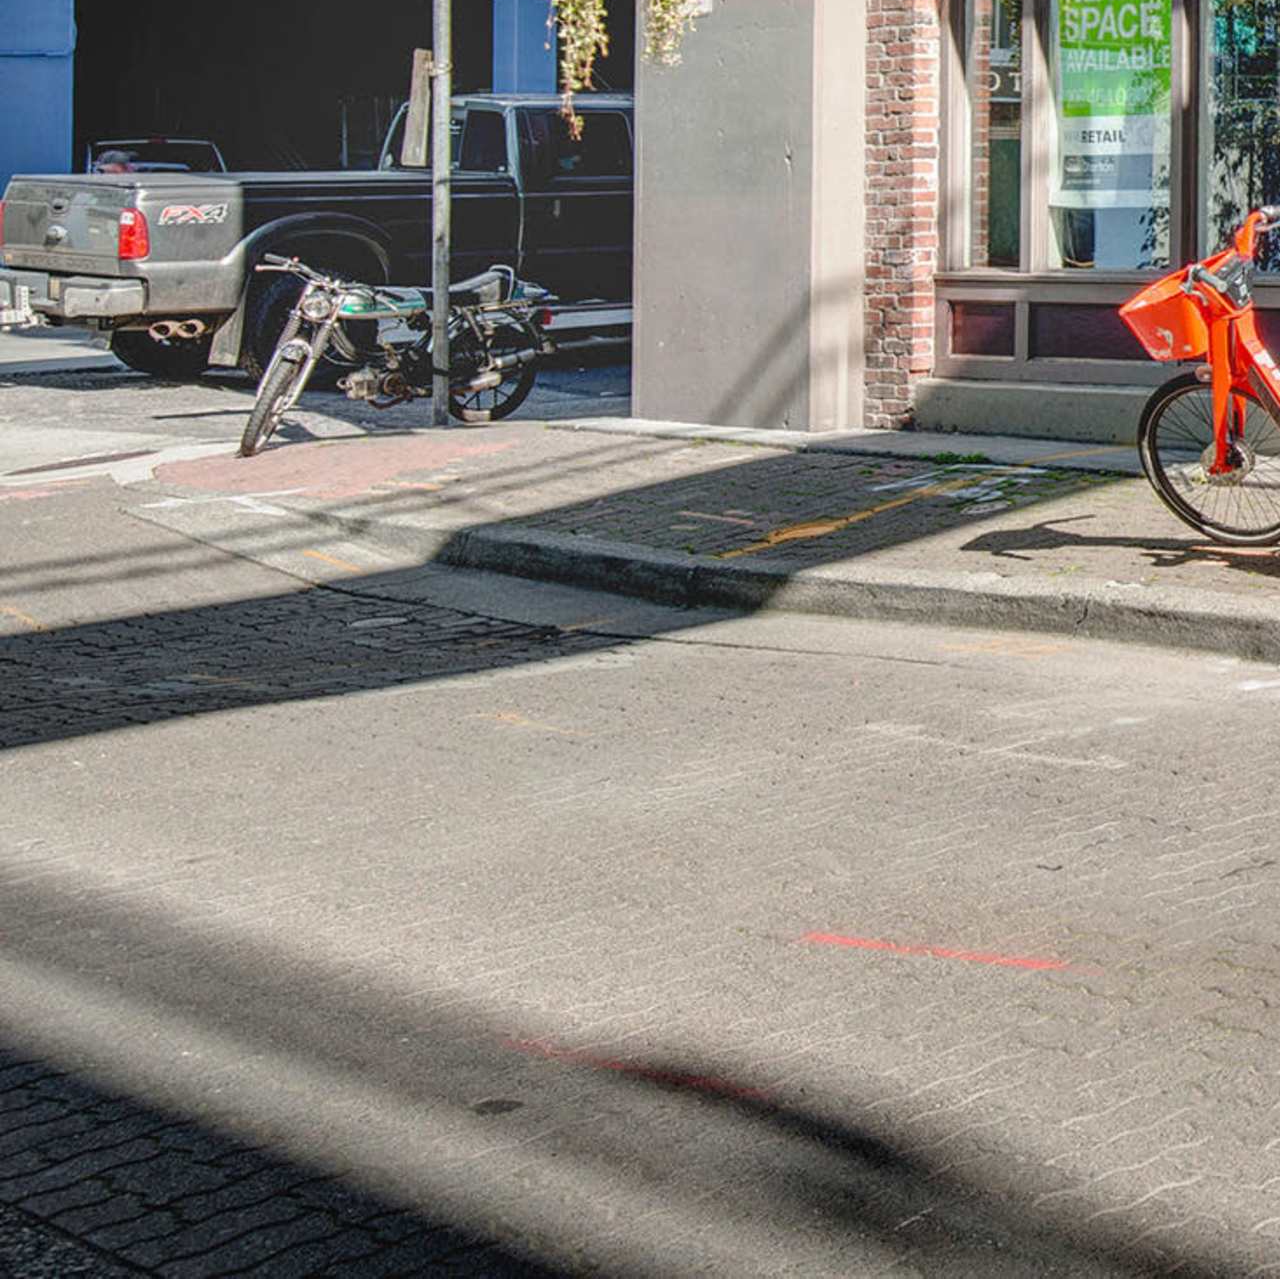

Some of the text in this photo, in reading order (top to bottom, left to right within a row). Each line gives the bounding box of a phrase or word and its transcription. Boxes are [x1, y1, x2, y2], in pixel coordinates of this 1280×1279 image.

[1065, 1, 1163, 41] SPACE
[1066, 44, 1171, 73] AVAILABLE
[157, 204, 229, 225] FX4
